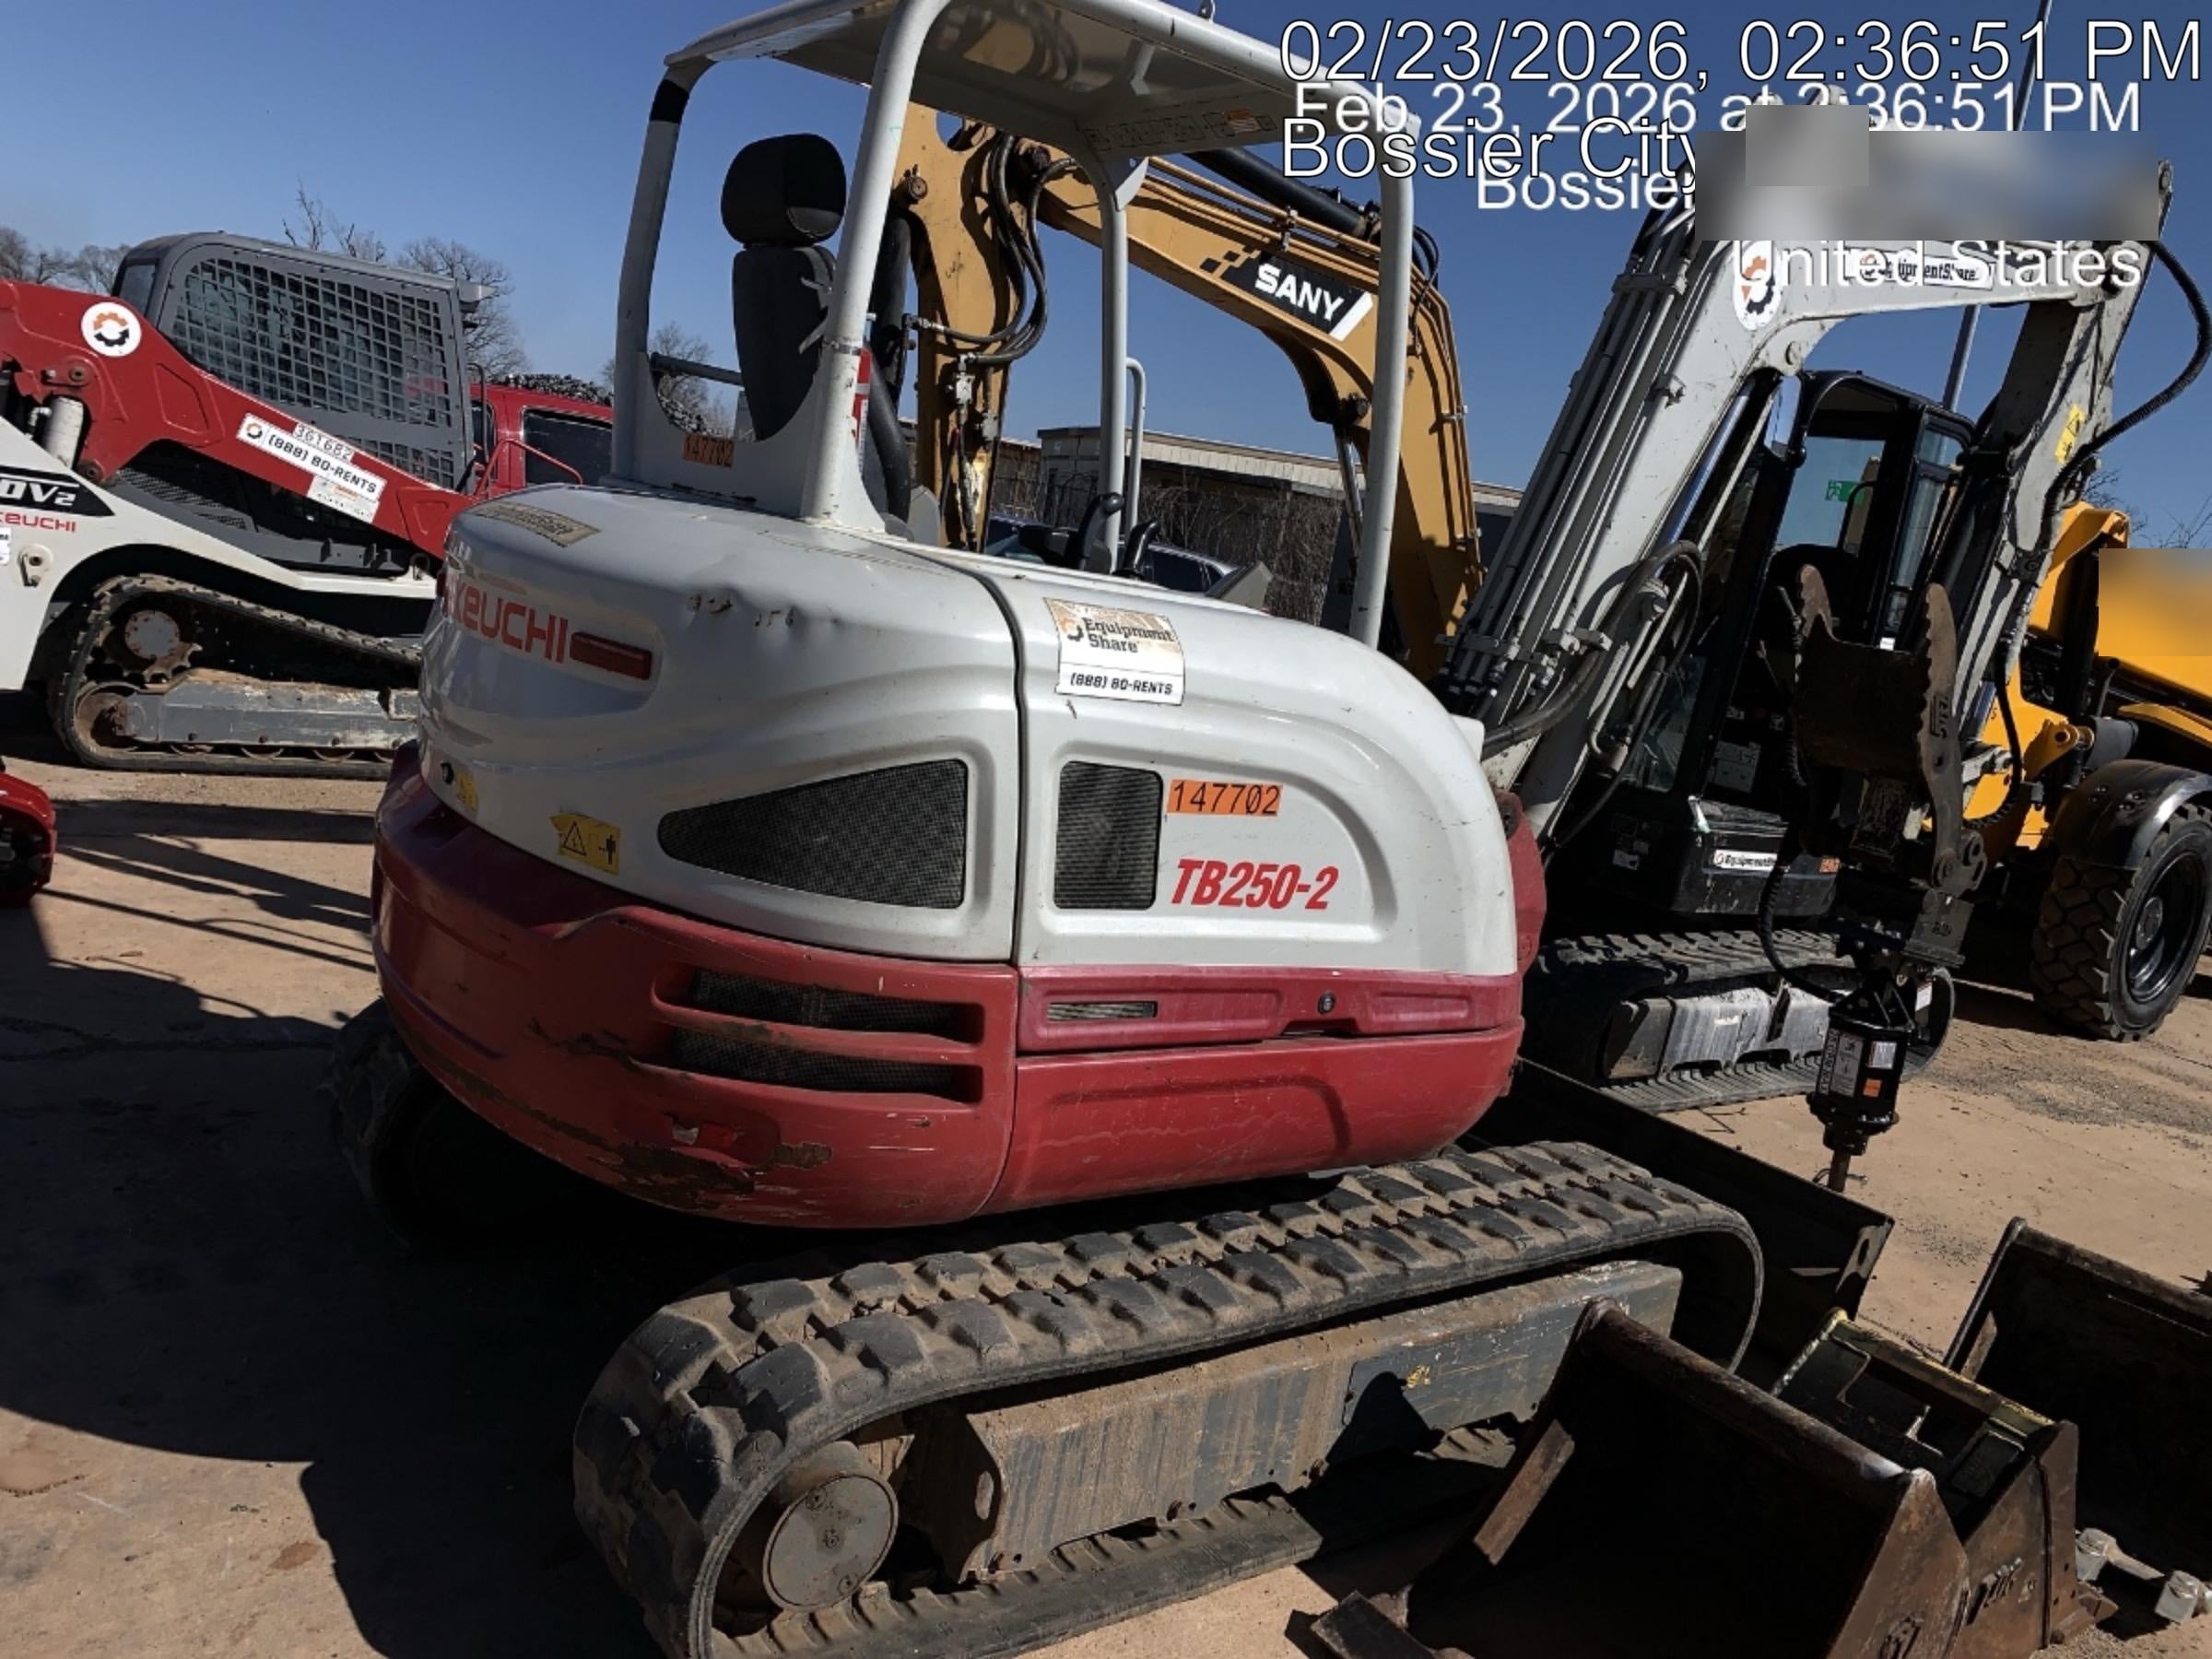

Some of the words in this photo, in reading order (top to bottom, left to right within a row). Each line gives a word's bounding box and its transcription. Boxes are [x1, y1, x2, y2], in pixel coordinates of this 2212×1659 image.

[1254, 263, 1345, 321] SANY
[268, 434, 309, 462] (888)
[312, 455, 377, 493] 80-RENTS
[1082, 617, 1175, 641] Equipment
[1088, 633, 1139, 653] Share
[1070, 672, 1108, 689] (888)
[1111, 677, 1173, 695] 80-RENTS
[1172, 781, 1281, 815] 147702
[1171, 858, 1339, 910] TB250-2
